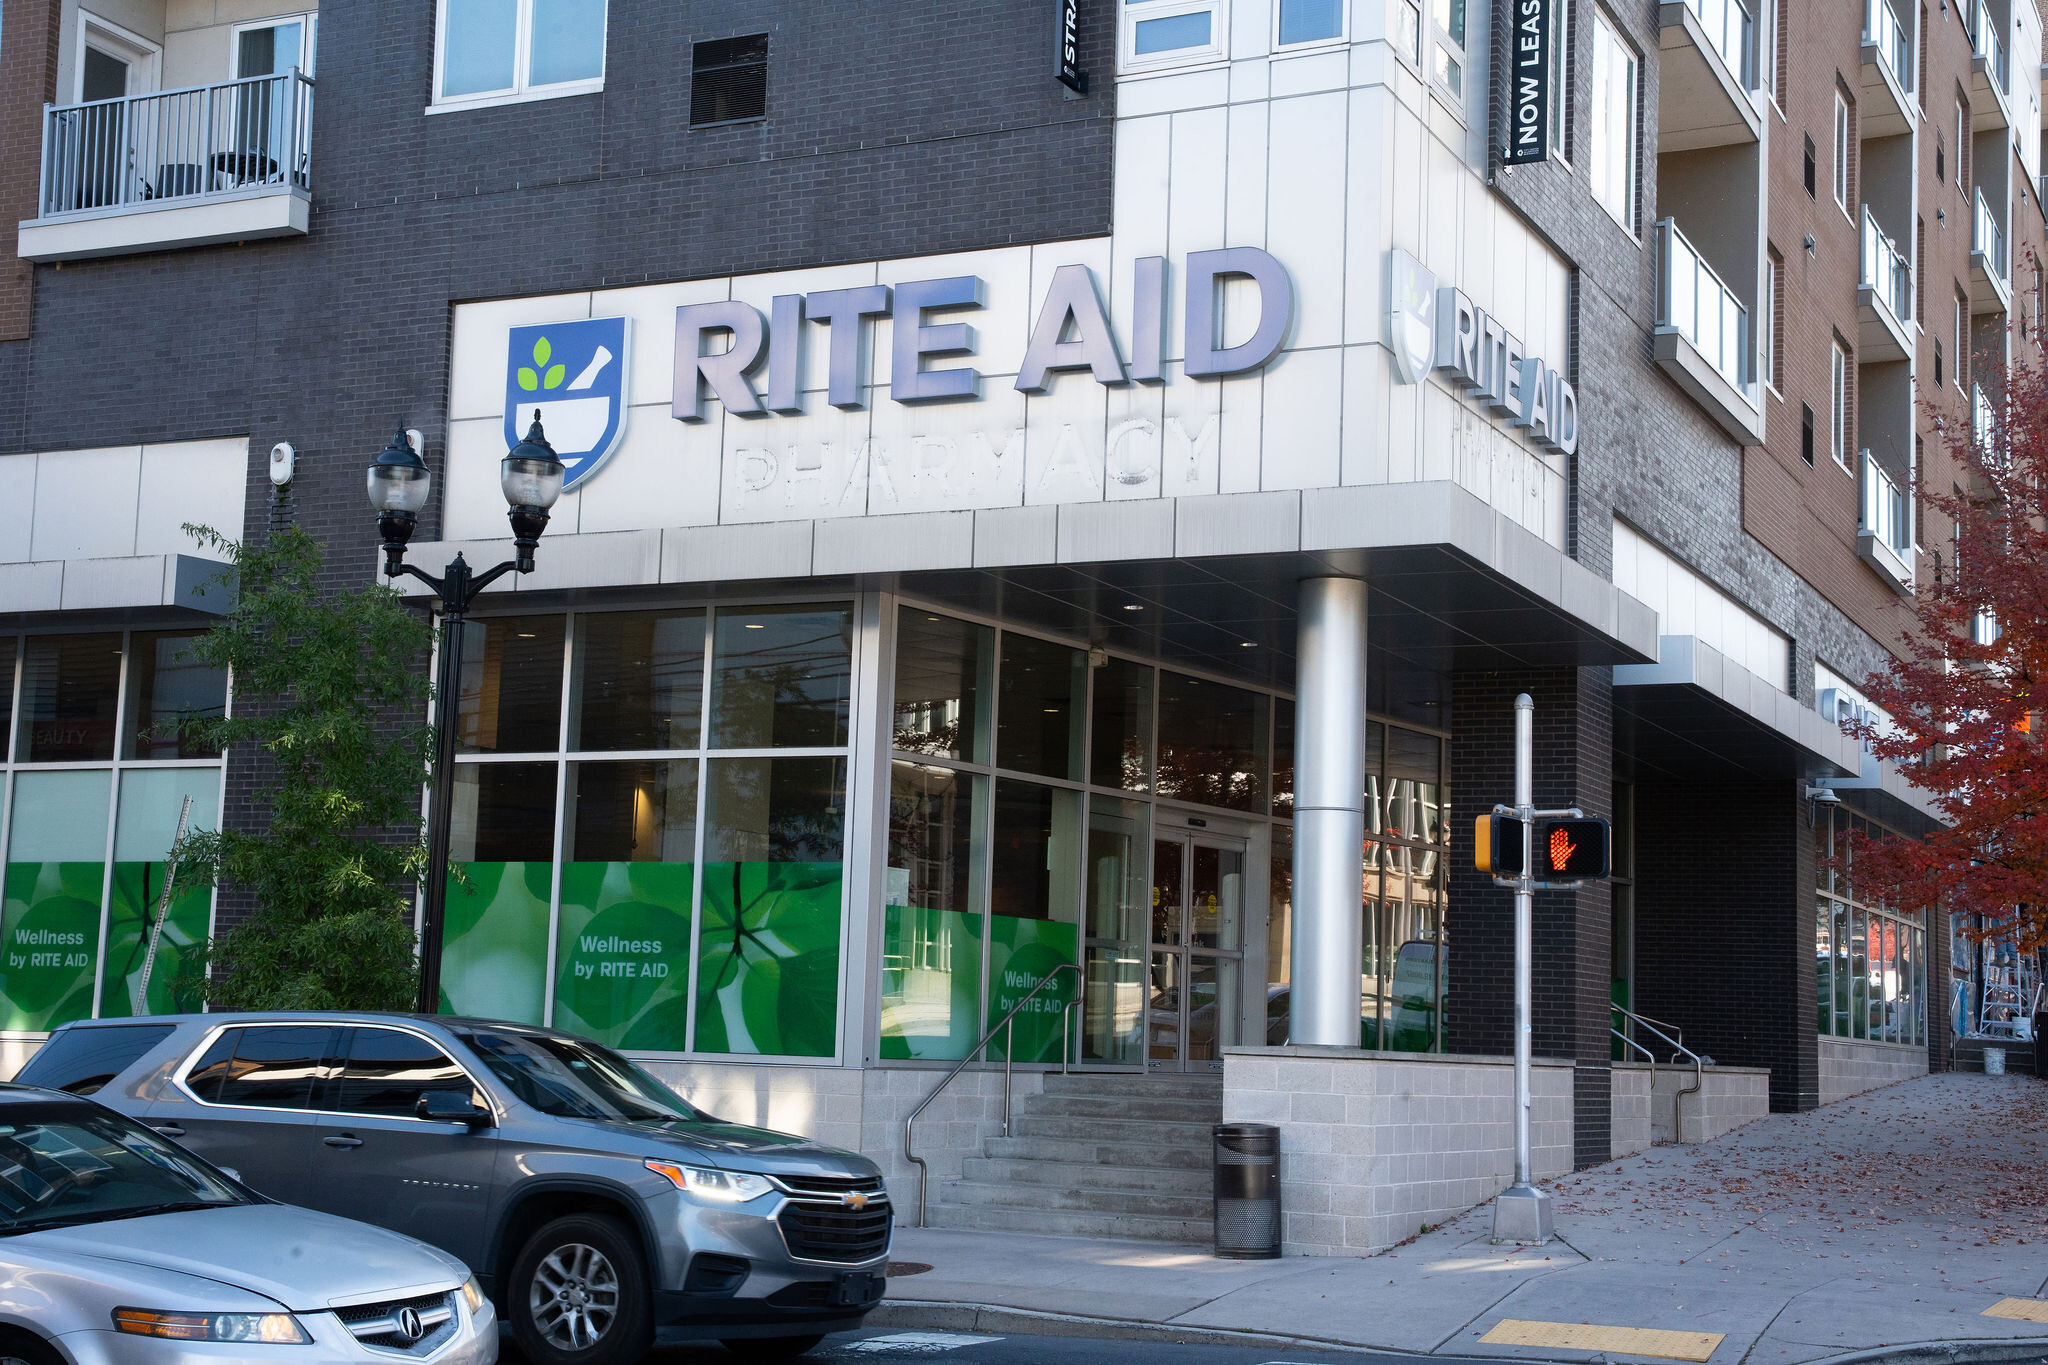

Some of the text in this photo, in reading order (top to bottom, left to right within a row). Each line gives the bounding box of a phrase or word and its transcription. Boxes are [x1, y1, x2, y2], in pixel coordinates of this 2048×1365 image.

[1520, 0, 1541, 67] LEAS
[1519, 77, 1539, 145] NOW
[672, 246, 1295, 422] RITE AID
[1437, 287, 1523, 418] RITE
[1514, 357, 1579, 456] AID
[734, 410, 1223, 512] PHARMACY
[15, 929, 84, 945] Wellness
[580, 935, 663, 954] Wellness
[9, 952, 89, 969] by RITE AID
[574, 961, 669, 980] by RITE AID
[1044, 998, 1062, 1013] AID
